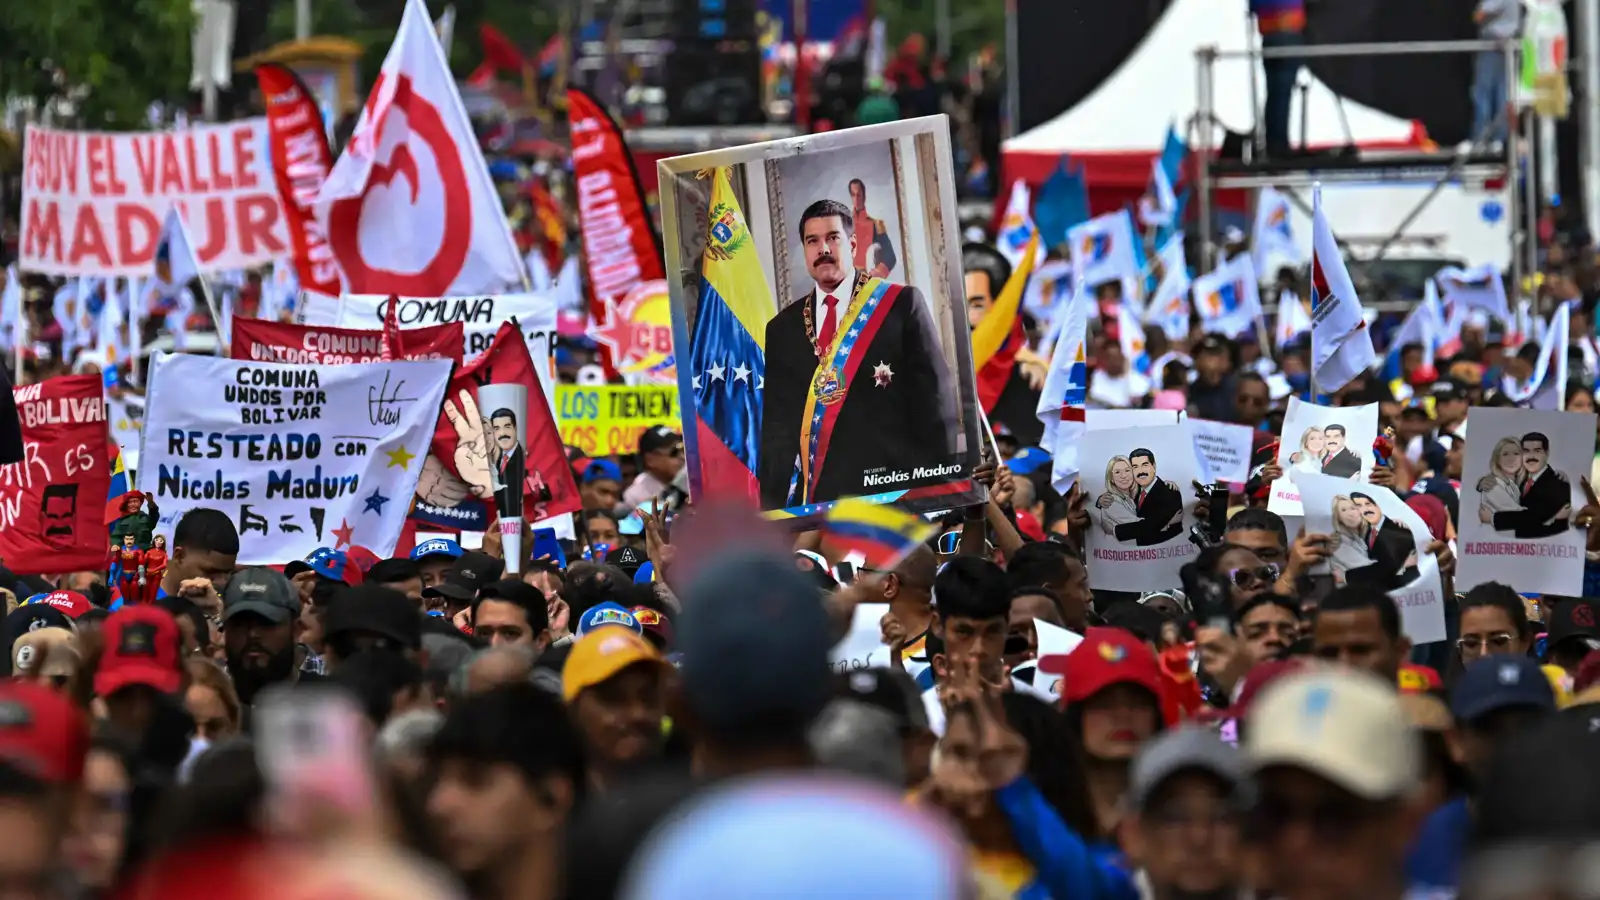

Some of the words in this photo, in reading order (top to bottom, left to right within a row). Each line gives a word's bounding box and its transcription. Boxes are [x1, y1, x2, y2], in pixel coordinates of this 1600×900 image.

[26, 130, 79, 195] PSUV
[87, 137, 126, 196] EL
[132, 128, 257, 196] VALLE
[236, 367, 320, 388] COMUNA
[225, 385, 281, 405] UNDOS
[292, 390, 327, 405] POR
[561, 391, 599, 420] LOS
[608, 391, 672, 419] TIENEN
[241, 406, 321, 424] BOLIVAR
[168, 428, 321, 460] RESTEADO
[335, 441, 367, 457] con
[64, 443, 94, 477] ES
[158, 463, 250, 500] Nicolas
[266, 465, 359, 500] Maduro
[863, 469, 910, 487] Nicolás
[912, 463, 961, 480] Maduro
[1465, 543, 1578, 560] #LOSQUEREMOSDEVUELTA
